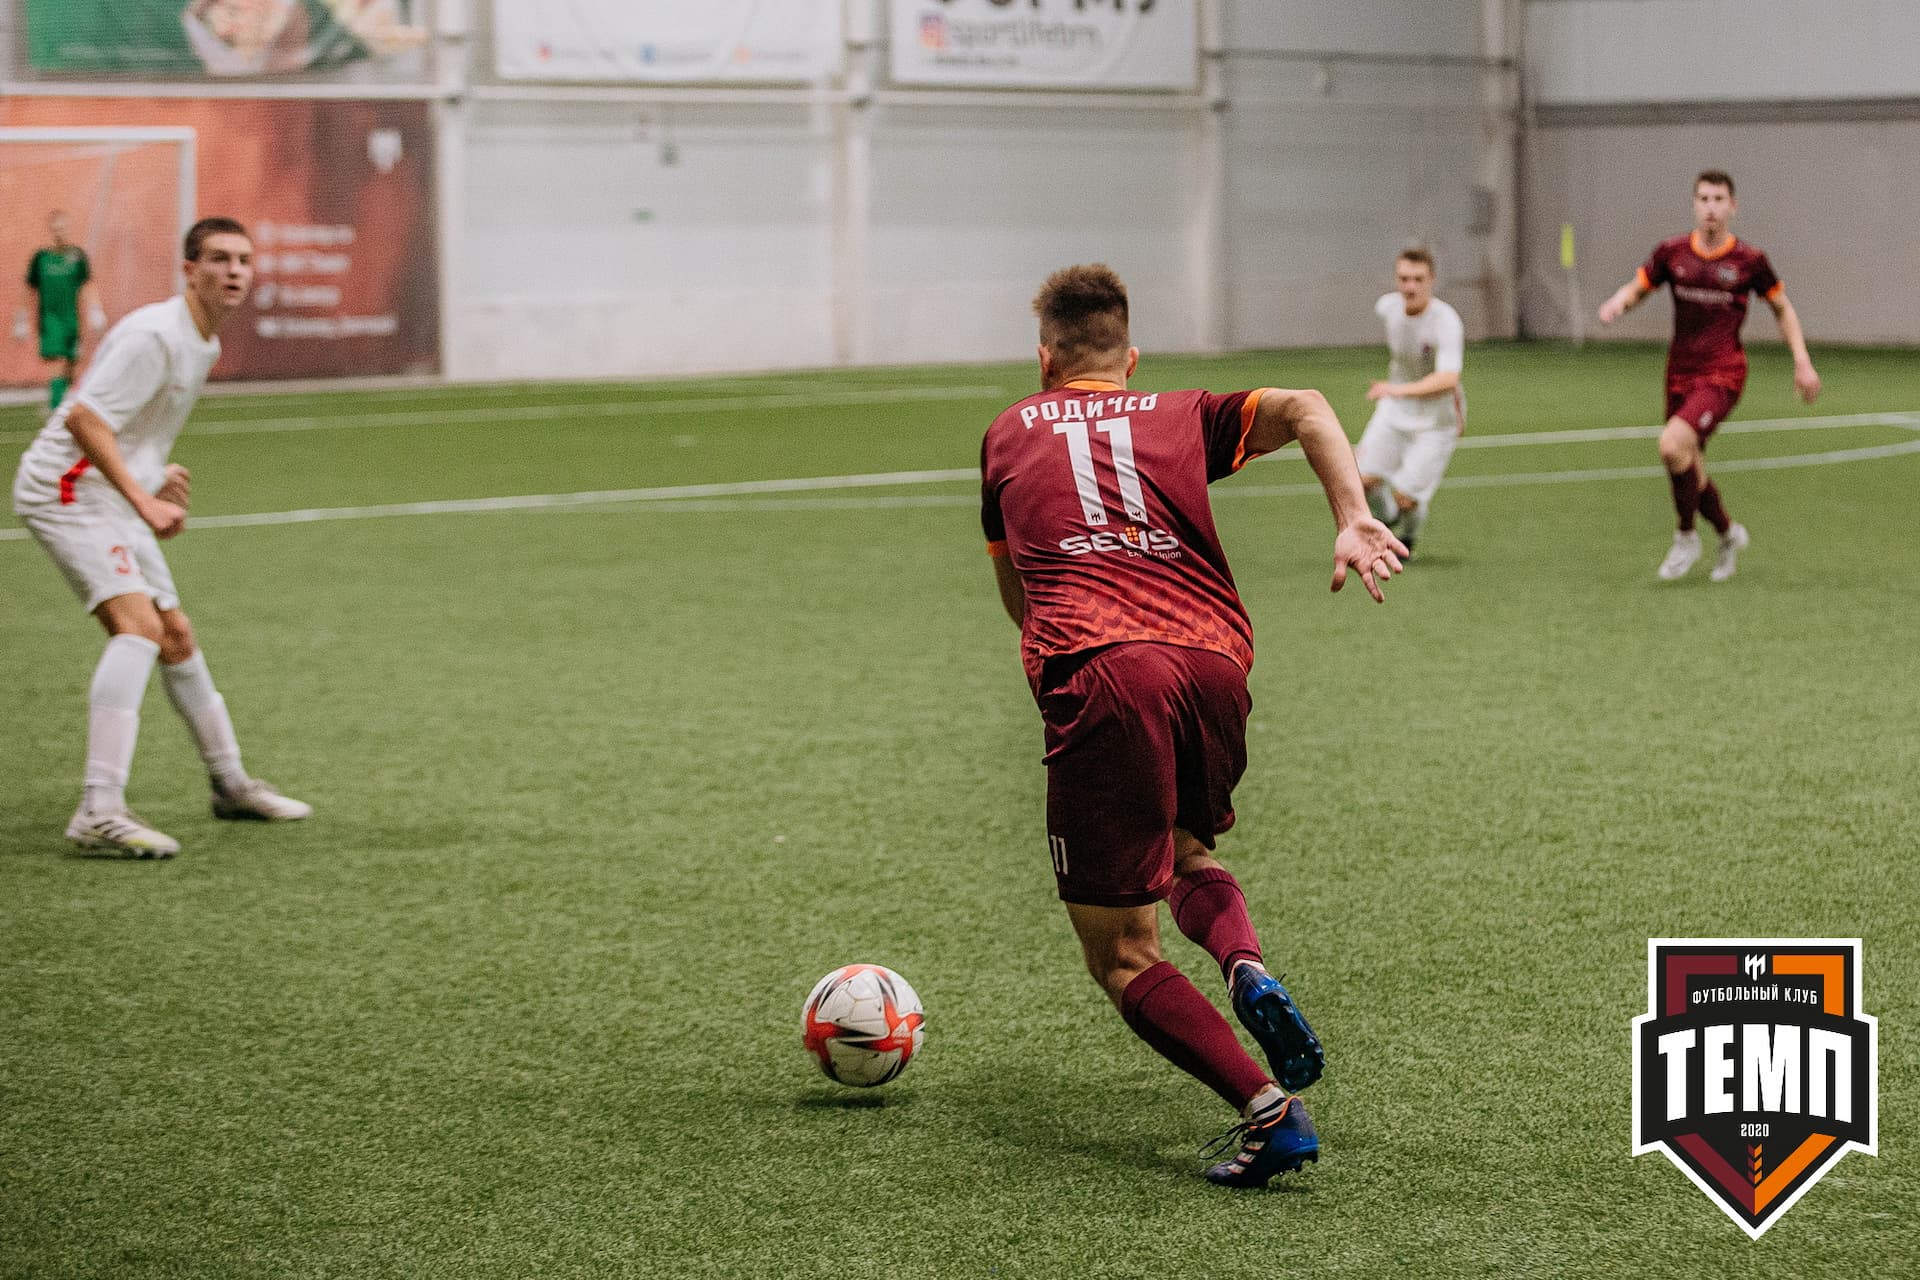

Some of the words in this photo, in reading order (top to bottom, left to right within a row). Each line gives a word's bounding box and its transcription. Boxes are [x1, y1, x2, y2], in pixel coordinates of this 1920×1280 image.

[1052, 416, 1148, 526] 11
[109, 545, 130, 575] 3
[1050, 834, 1069, 875] 11
